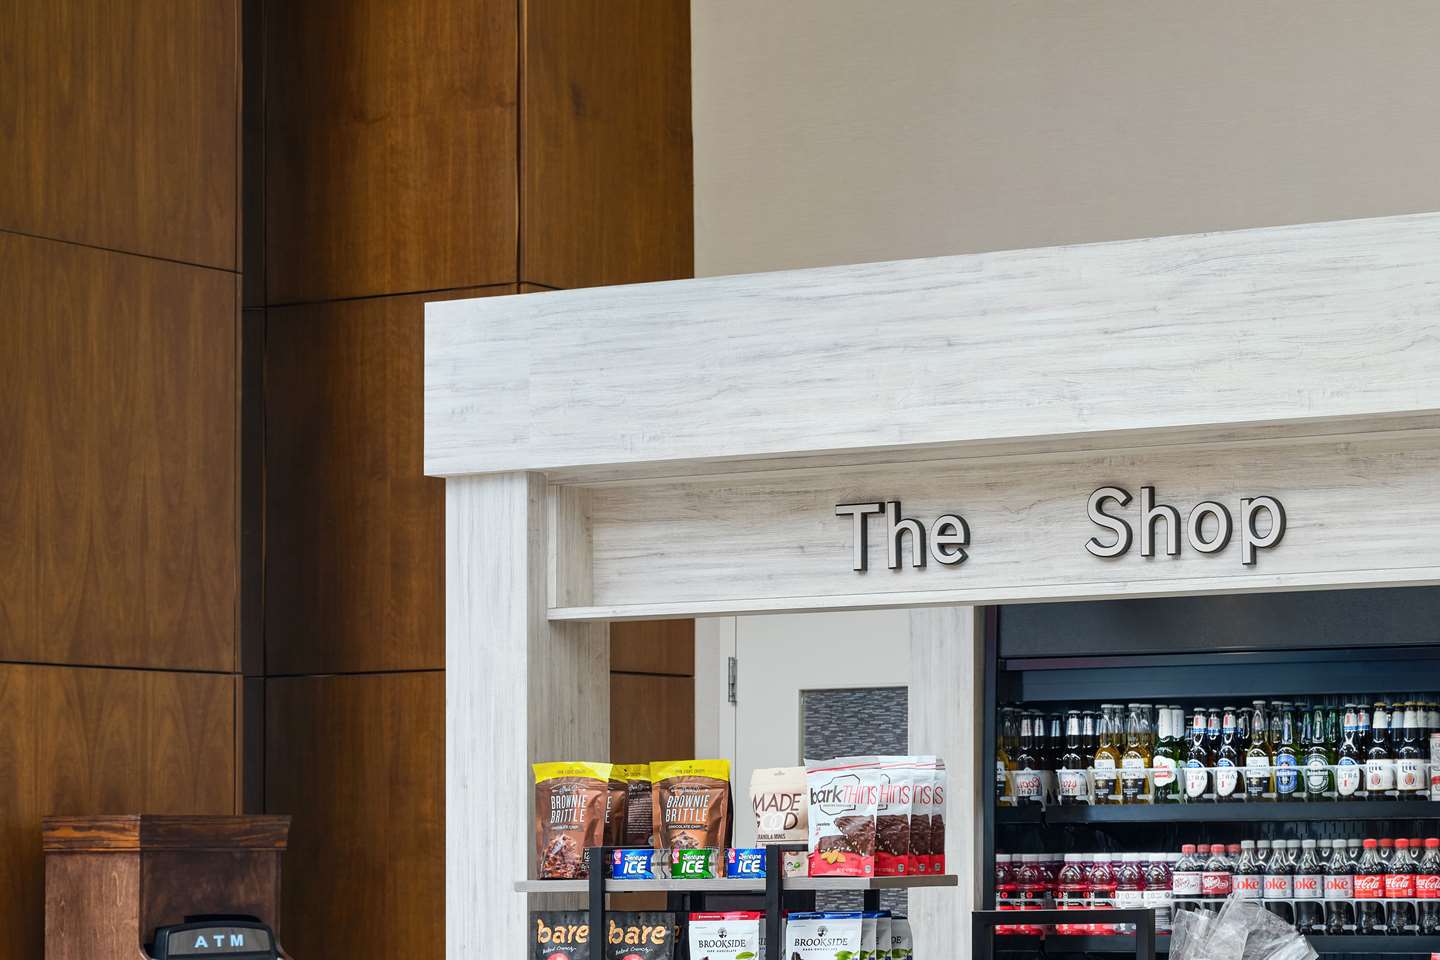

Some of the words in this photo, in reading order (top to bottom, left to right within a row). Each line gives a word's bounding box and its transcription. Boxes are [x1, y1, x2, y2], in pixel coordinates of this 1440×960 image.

[835, 501, 971, 571] The
[1085, 486, 1287, 566] Shop
[666, 794, 711, 809] BROWNIE
[665, 808, 709, 822] BRITTLE
[623, 861, 647, 873] ICE
[681, 861, 704, 873] ICE
[737, 860, 761, 873] ICE
[1264, 878, 1286, 889] oke
[1295, 878, 1317, 889] oke
[537, 919, 590, 944] bare
[608, 919, 667, 944] bare
[194, 934, 245, 948] ATM
[698, 939, 746, 949] BROOKSIDE
[794, 937, 848, 947] BROOKSIDE
